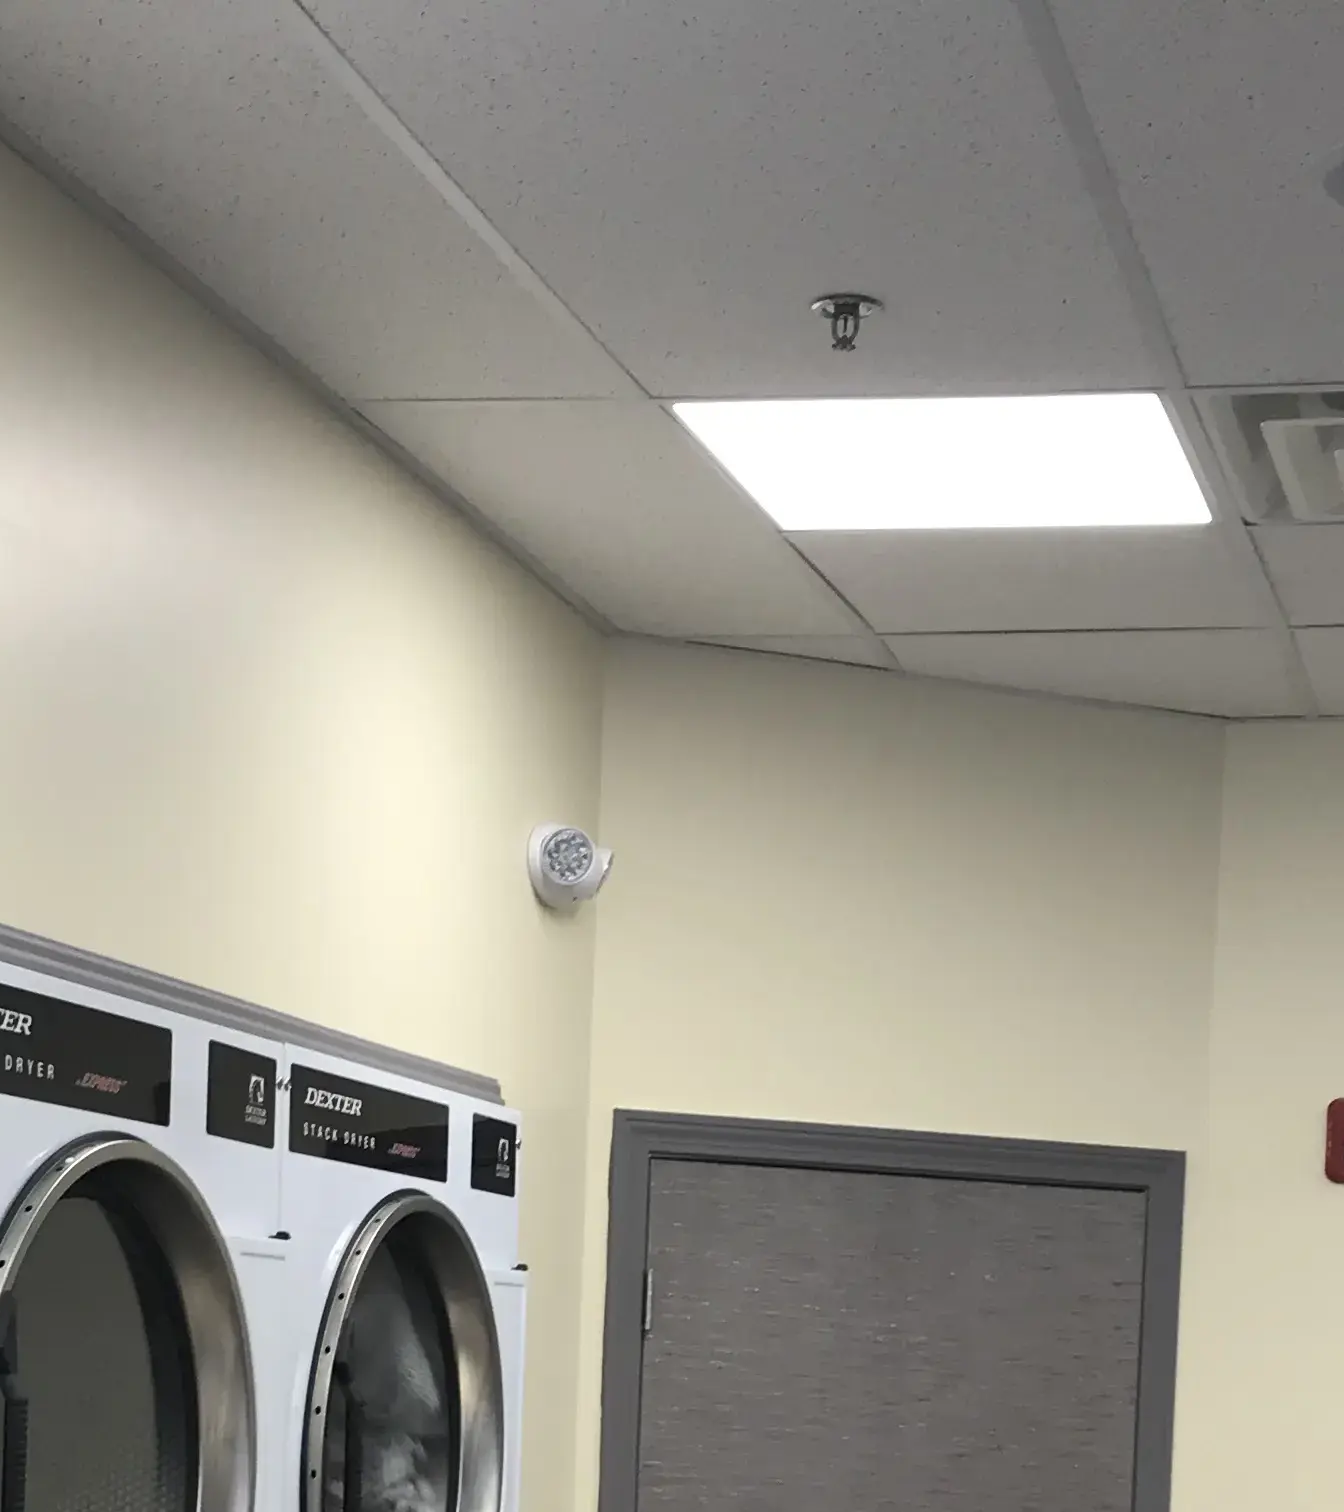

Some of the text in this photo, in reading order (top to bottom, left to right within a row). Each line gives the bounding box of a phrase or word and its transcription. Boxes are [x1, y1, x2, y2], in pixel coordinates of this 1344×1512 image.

[4, 1054, 55, 1079] DRYER
[305, 1088, 362, 1117] DEXTER
[303, 1121, 337, 1142] STACK
